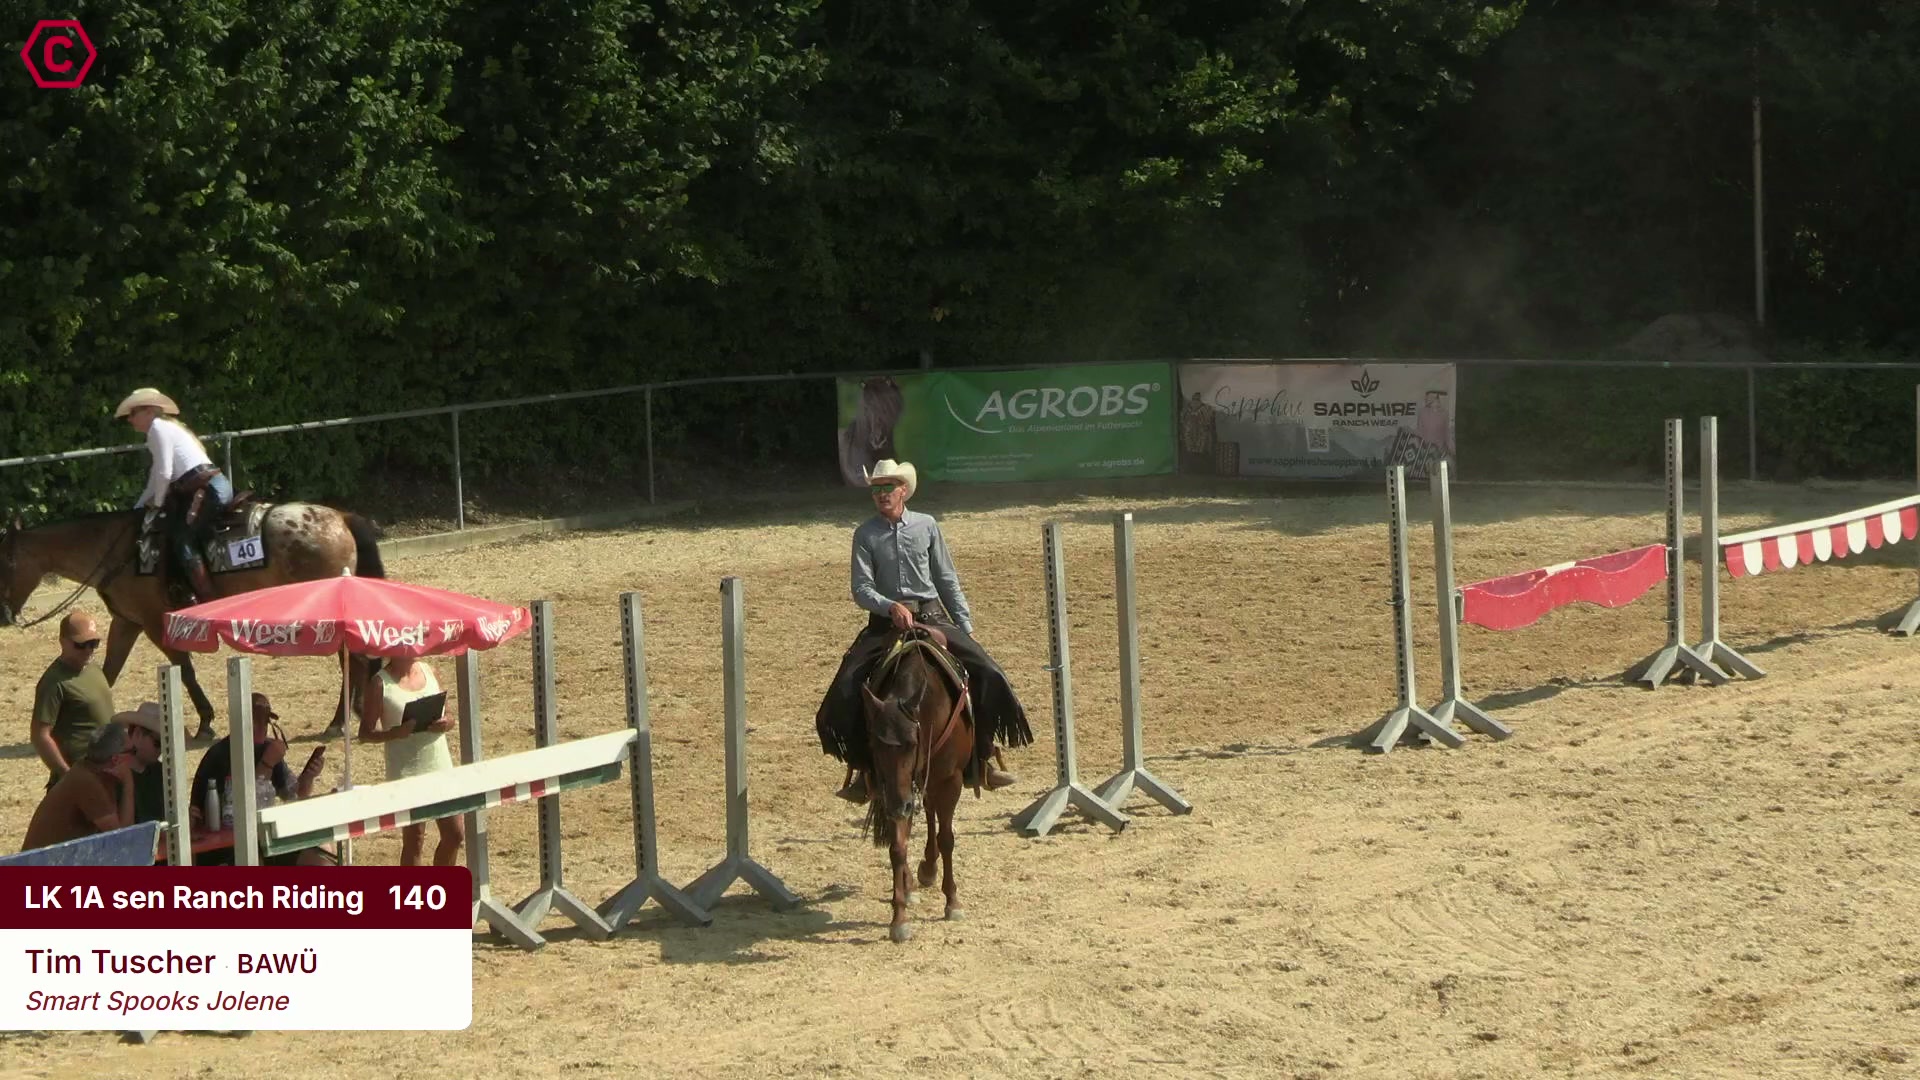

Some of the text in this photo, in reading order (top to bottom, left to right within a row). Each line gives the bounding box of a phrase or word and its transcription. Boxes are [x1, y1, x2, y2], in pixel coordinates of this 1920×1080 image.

[1313, 402, 1417, 417] SAPPHIRE
[1332, 419, 1370, 427] RANCH
[1078, 457, 1145, 469] www.agrobs.de
[238, 542, 256, 559] 40
[231, 619, 302, 645] West
[355, 619, 430, 647] West
